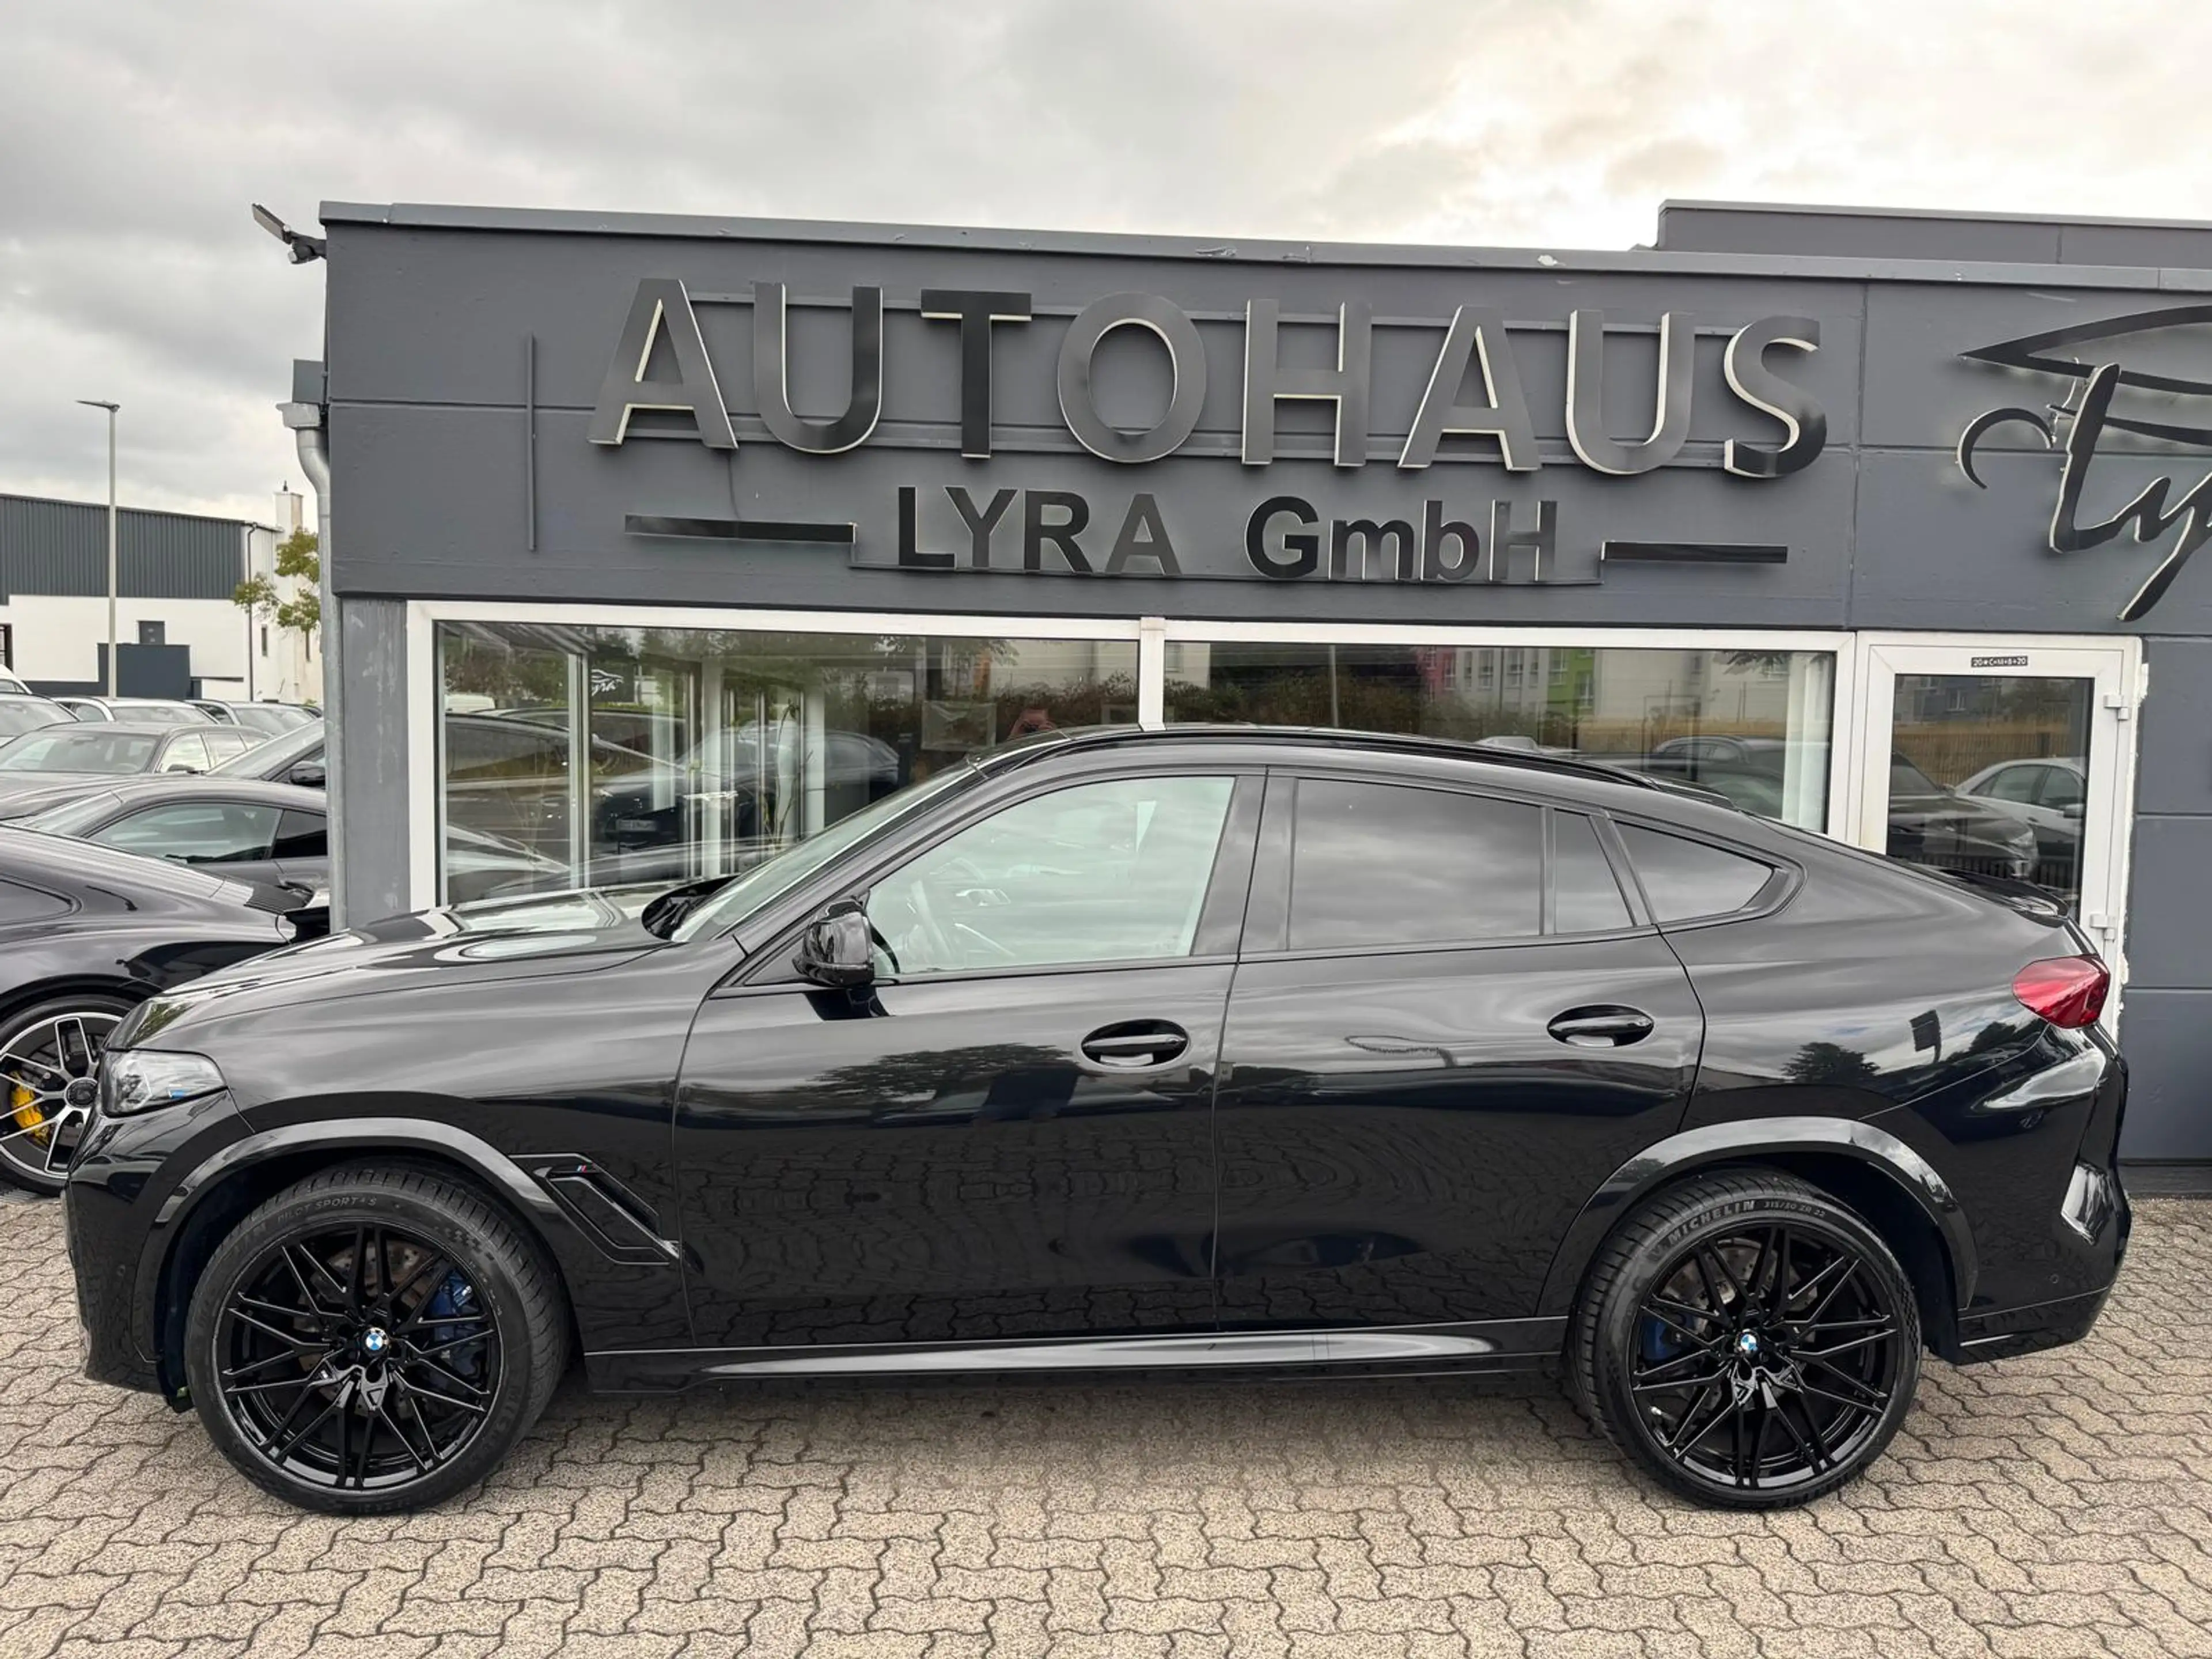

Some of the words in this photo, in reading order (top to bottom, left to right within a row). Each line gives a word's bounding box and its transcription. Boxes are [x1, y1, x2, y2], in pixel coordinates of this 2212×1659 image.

[586, 278, 1827, 478] AUTOHAUS
[1957, 363, 2212, 622] Ly
[898, 486, 1181, 575] LYRA
[1245, 495, 1556, 582] GmbH
[591, 681, 617, 696] yra
[316, 1197, 359, 1210] SPORT
[1668, 1200, 1755, 1245] MICHELIN
